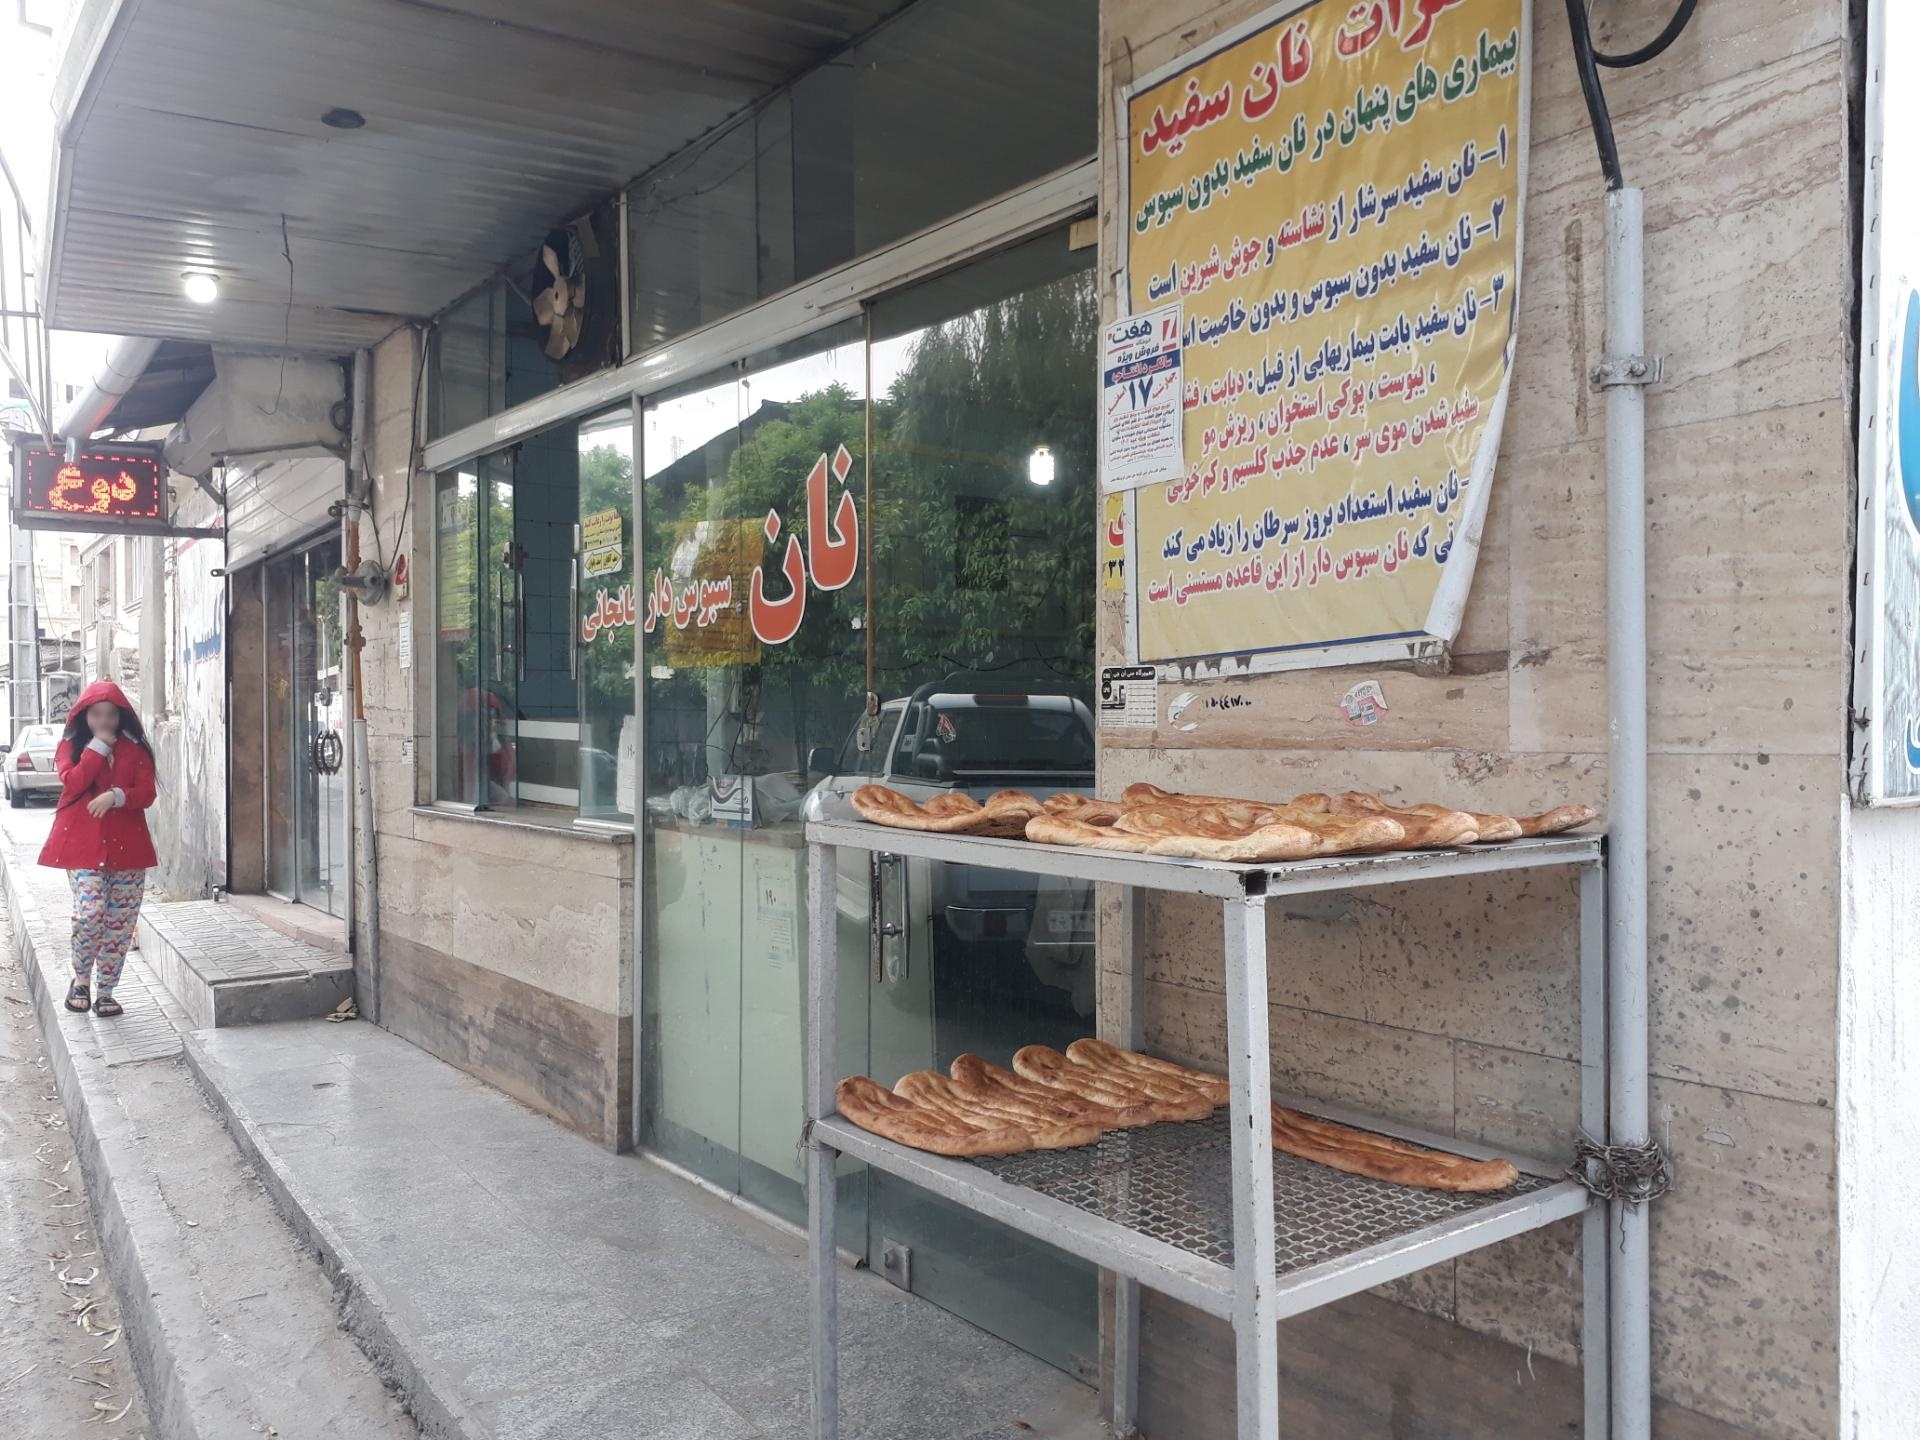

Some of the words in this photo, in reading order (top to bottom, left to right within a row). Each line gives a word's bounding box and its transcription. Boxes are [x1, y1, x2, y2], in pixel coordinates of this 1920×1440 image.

[1243, 22, 1310, 119] نان
[1443, 30, 1517, 100] بیماری
[1395, 60, 1438, 122] های
[1143, 80, 1230, 153] سفید
[1312, 112, 1334, 160] در
[1340, 87, 1390, 145] پنهان
[1234, 137, 1273, 185] سفید
[1278, 115, 1307, 171] نان
[1187, 160, 1229, 211] بدون
[1403, 162, 1444, 206] سفید
[1448, 143, 1475, 194] نان
[1136, 186, 1184, 232] سبوس
[1277, 203, 1326, 247] نشاسته
[1329, 195, 1344, 241] از
[1223, 238, 1262, 280] جوش
[1265, 236, 1275, 265] و
[1401, 233, 1441, 278] سفید
[1445, 215, 1473, 267] نان
[1149, 262, 1177, 300] است
[1180, 247, 1220, 294] شیرین
[1355, 253, 1397, 298] بدون
[1250, 292, 1287, 333] بدون
[1290, 292, 1299, 320] و
[1303, 273, 1351, 320] سبوس
[1454, 290, 1477, 336] نان
[1112, 319, 1153, 344] هفت
[1183, 316, 1196, 348] اس
[1199, 300, 1247, 346] خاصیت
[1379, 314, 1411, 354] بابت
[1415, 305, 1450, 344] سفید
[1135, 342, 1160, 360] فروش
[1287, 348, 1301, 388] از
[1129, 375, 1154, 411] ۱۷
[1211, 369, 1245, 406] دیابت
[1257, 352, 1285, 396] قبیل
[1378, 366, 1425, 401] یبوست
[1268, 386, 1323, 437] استخوان
[1327, 379, 1365, 421] پوکی
[1451, 390, 1480, 430] سفید
[1204, 427, 1216, 455] مو
[1219, 413, 1255, 450] ریزش
[1375, 420, 1408, 454] موی
[1411, 400, 1449, 446] شدن
[1232, 445, 1268, 489] کلسیم
[1272, 439, 1307, 477] جذب
[1311, 434, 1339, 471] عدم
[1353, 431, 1372, 462] سر
[1203, 459, 1219, 496] کم
[1222, 467, 1229, 492] و
[1397, 478, 1432, 518] سفید
[1436, 468, 1459, 514] نان
[1303, 507, 1334, 541] بروز
[1337, 484, 1393, 524] استعداد
[749, 442, 859, 646] نان
[1163, 529, 1183, 559] کند
[1186, 535, 1206, 562] می
[1208, 521, 1235, 555] زیاد
[1236, 517, 1249, 552] را
[1252, 509, 1300, 550] سرطان
[1412, 525, 1431, 558] که
[1226, 554, 1263, 589] قاعده
[1265, 552, 1289, 591] این
[1292, 548, 1305, 588] از
[1309, 545, 1331, 586] دار
[1335, 548, 1380, 581] سبوس
[1383, 530, 1409, 573] نان
[644, 566, 673, 633] دار
[673, 574, 732, 630] سبوس
[1148, 571, 1174, 602] است
